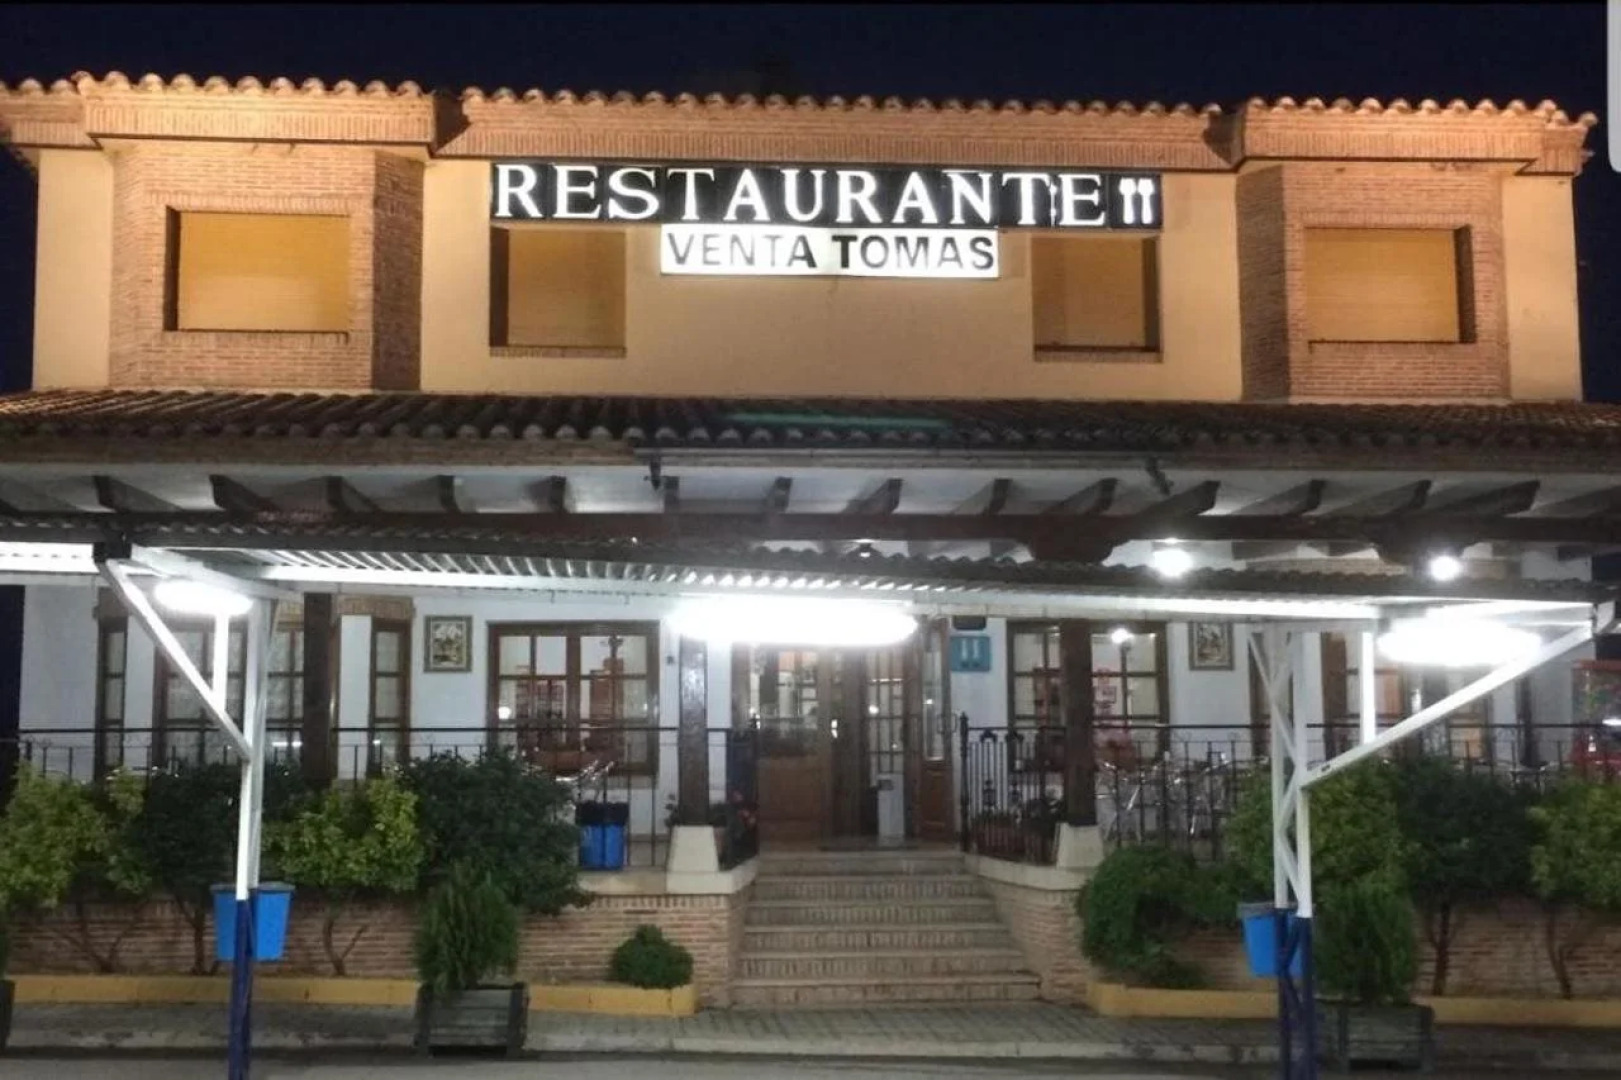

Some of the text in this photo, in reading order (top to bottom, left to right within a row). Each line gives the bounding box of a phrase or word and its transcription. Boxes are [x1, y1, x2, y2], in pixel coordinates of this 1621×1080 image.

[495, 164, 1106, 227] RESTAURANTE
[667, 232, 995, 271] VENTA TOMAS
